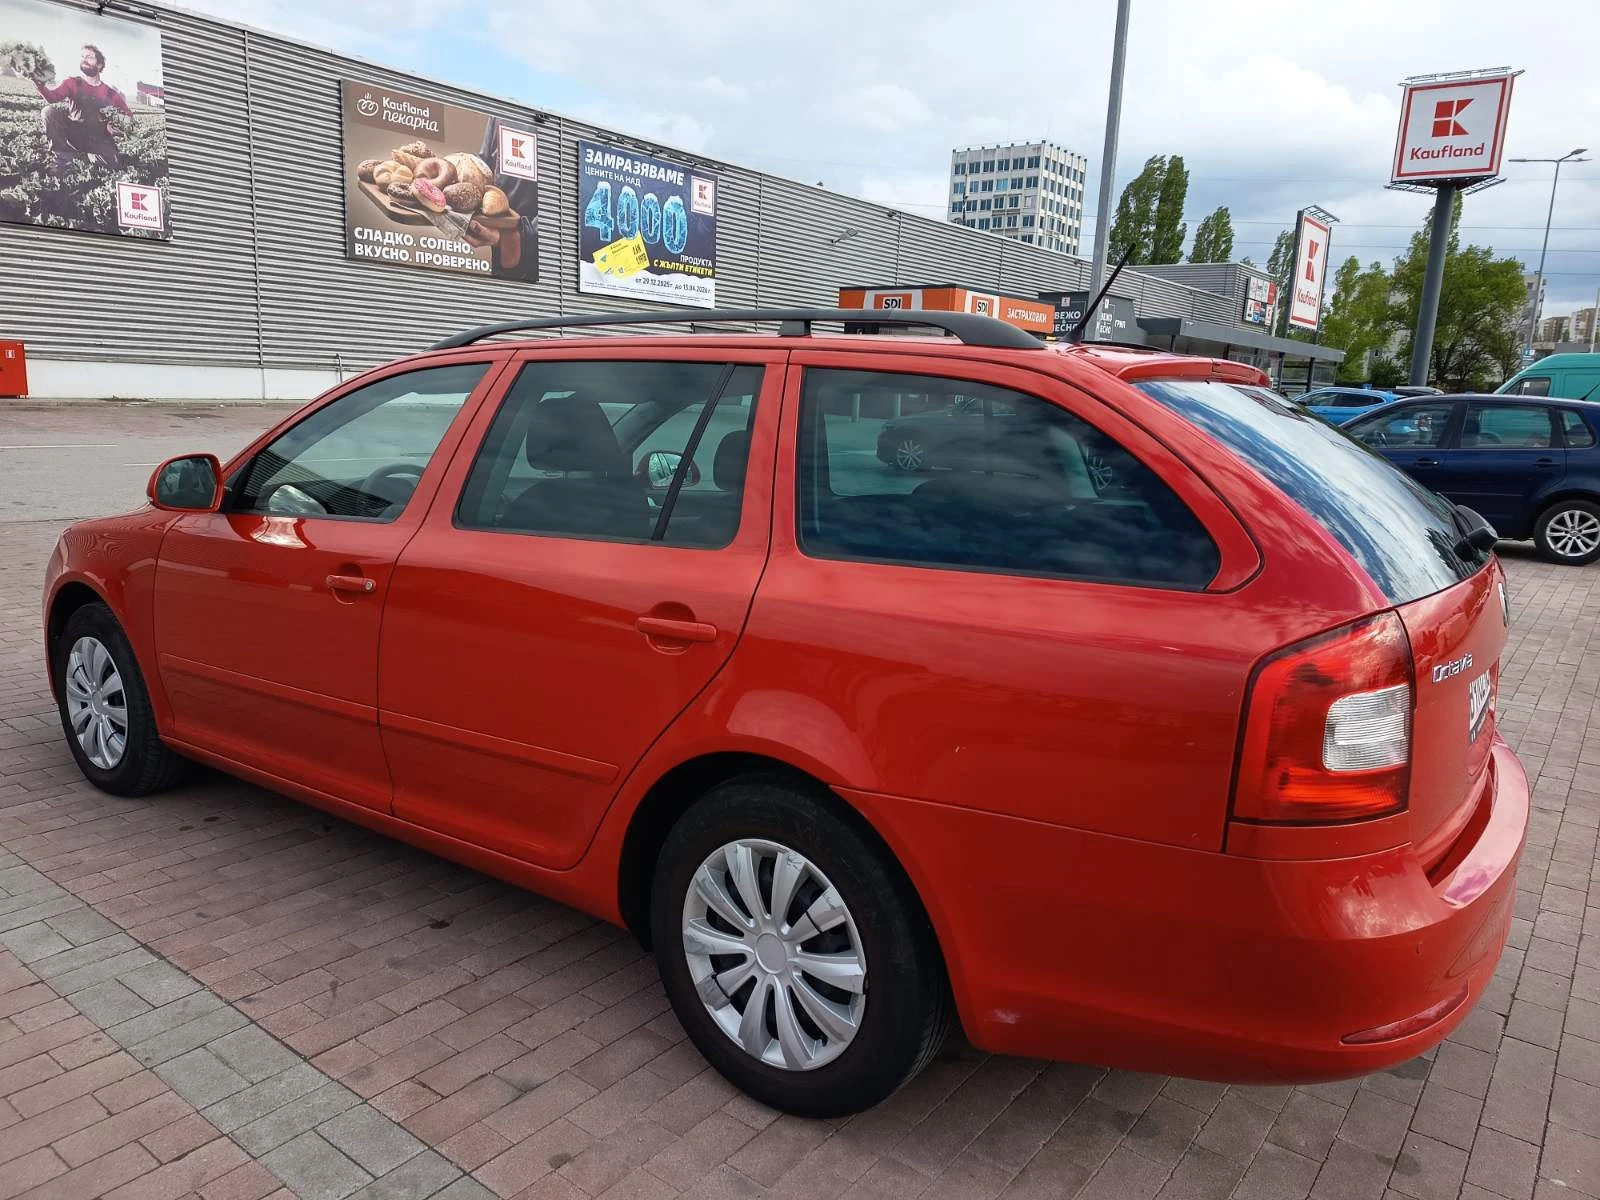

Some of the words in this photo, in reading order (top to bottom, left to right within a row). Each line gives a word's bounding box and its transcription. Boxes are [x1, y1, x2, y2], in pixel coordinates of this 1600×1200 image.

[382, 96, 430, 118] Kaufland
[382, 109, 439, 132] пекарна
[1410, 142, 1485, 161] Kaufland
[504, 159, 532, 171] Kaufland
[584, 148, 685, 186] ЗАМРАЗЯВАМЕ
[584, 165, 613, 180] ЦЕНИТЕ
[614, 173, 625, 183] НА
[625, 175, 641, 187] НАД
[124, 211, 157, 222] Kaufland
[584, 180, 688, 254] 4000
[354, 226, 417, 247] СЛАДКО.
[419, 236, 474, 255] СОЛЕНО.
[354, 243, 412, 262] ВКУСНО.
[415, 250, 493, 272] ПРОВЕРЕНО.
[680, 254, 713, 267] ПРОДУКТА
[659, 260, 683, 270] ЖЪЛТИ
[684, 265, 713, 277] ЕТИКЕТИ
[883, 298, 902, 309] SDI
[976, 301, 988, 313] SDI
[1297, 288, 1317, 307] Kaufland
[1007, 307, 1047, 323] ЗАСТРАХОВКИ
[1054, 310, 1081, 320] ВЕЖО
[1432, 653, 1473, 684] Octavia
